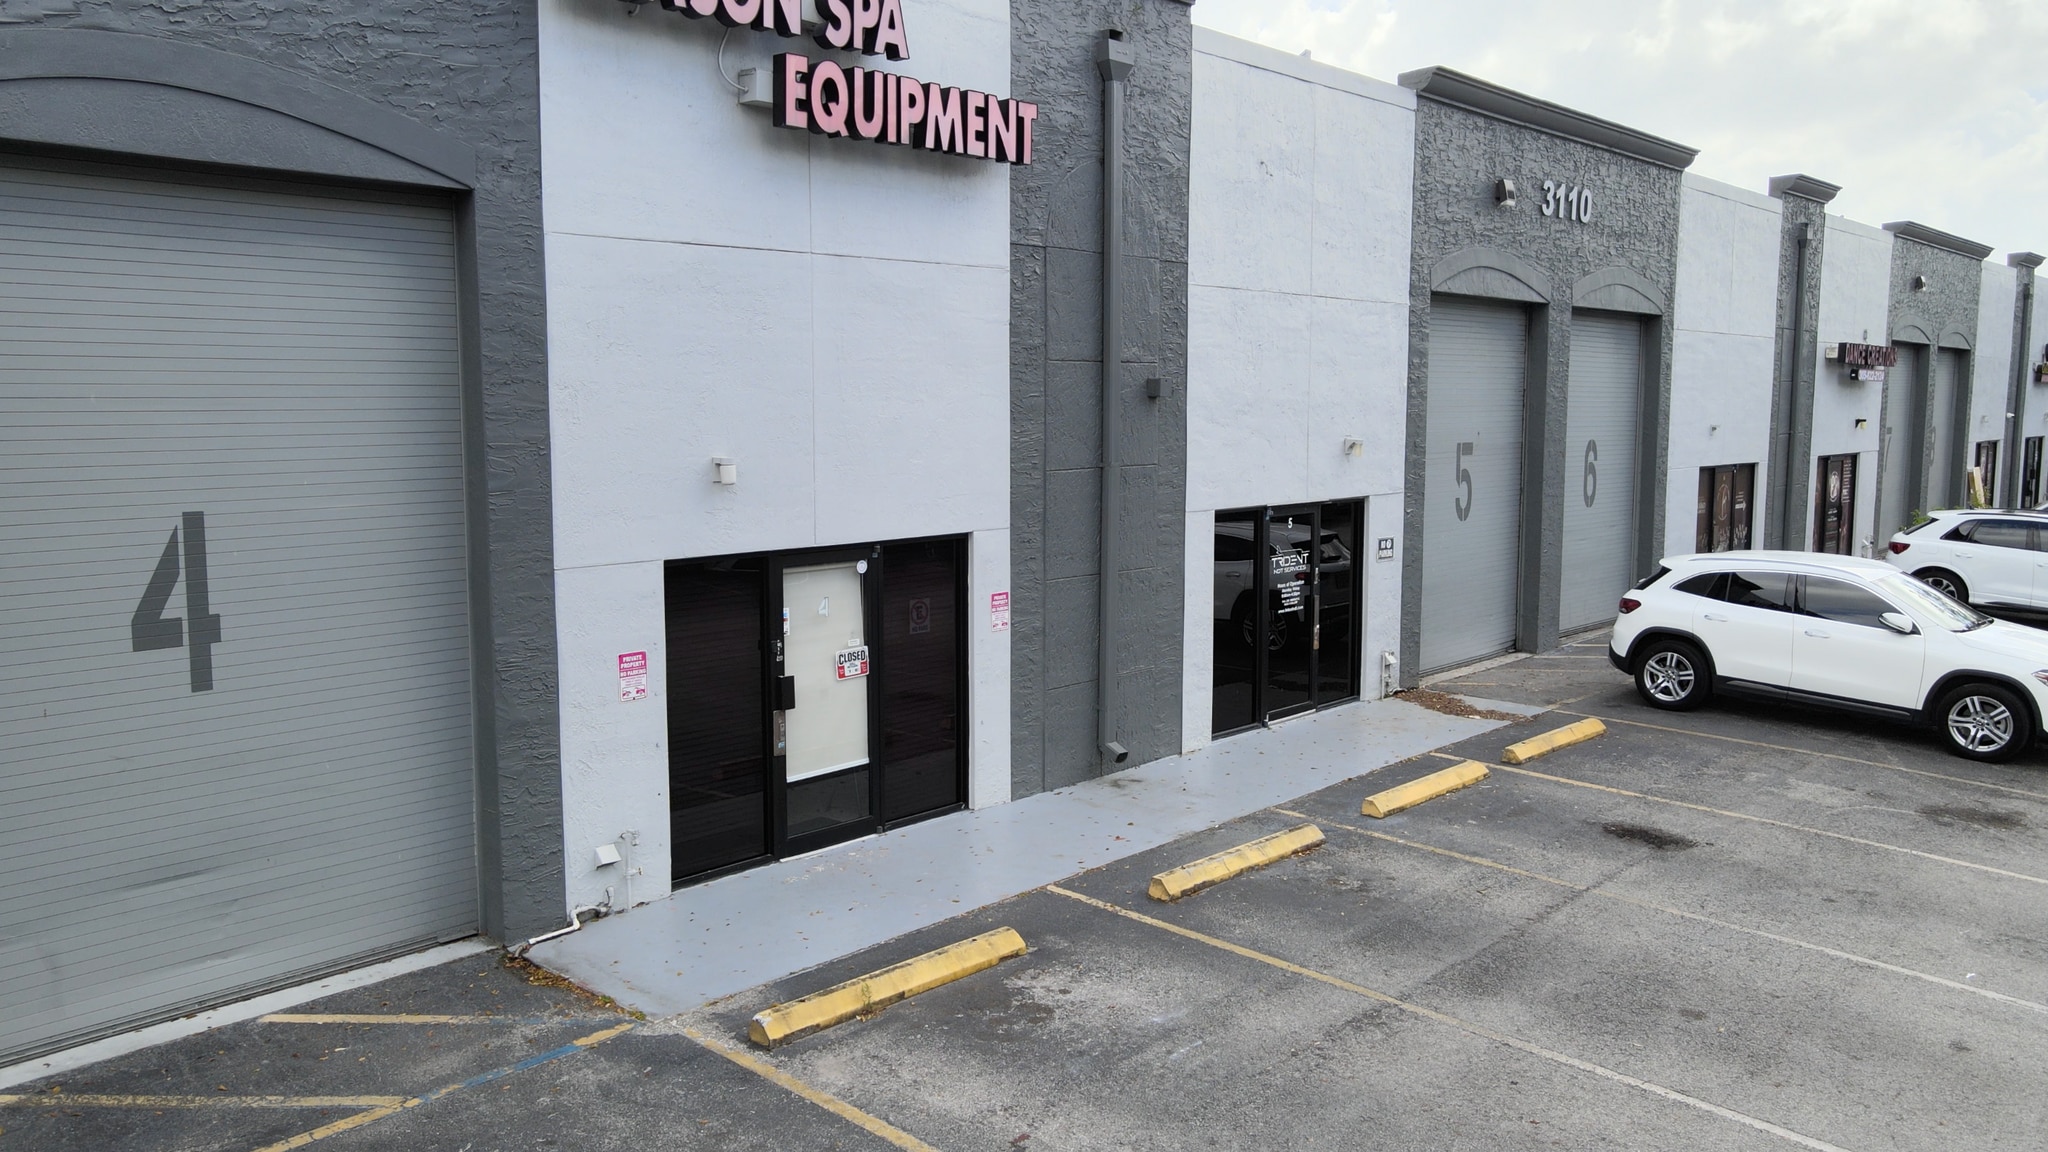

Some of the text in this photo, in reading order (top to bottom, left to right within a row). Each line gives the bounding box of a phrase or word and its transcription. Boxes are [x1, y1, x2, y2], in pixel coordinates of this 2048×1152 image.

[820, 0, 909, 59] SPA
[778, 53, 1038, 165] EQUIPMENT
[1541, 180, 1593, 223] 3110
[1845, 343, 1865, 365] DANCE
[1455, 442, 1474, 522] 5
[1582, 439, 1598, 508] 6
[1287, 517, 1293, 529] 5
[130, 511, 222, 693] 4
[818, 596, 829, 617] 4
[620, 661, 645, 669] PROPERTY
[838, 650, 866, 665] CLOSED
